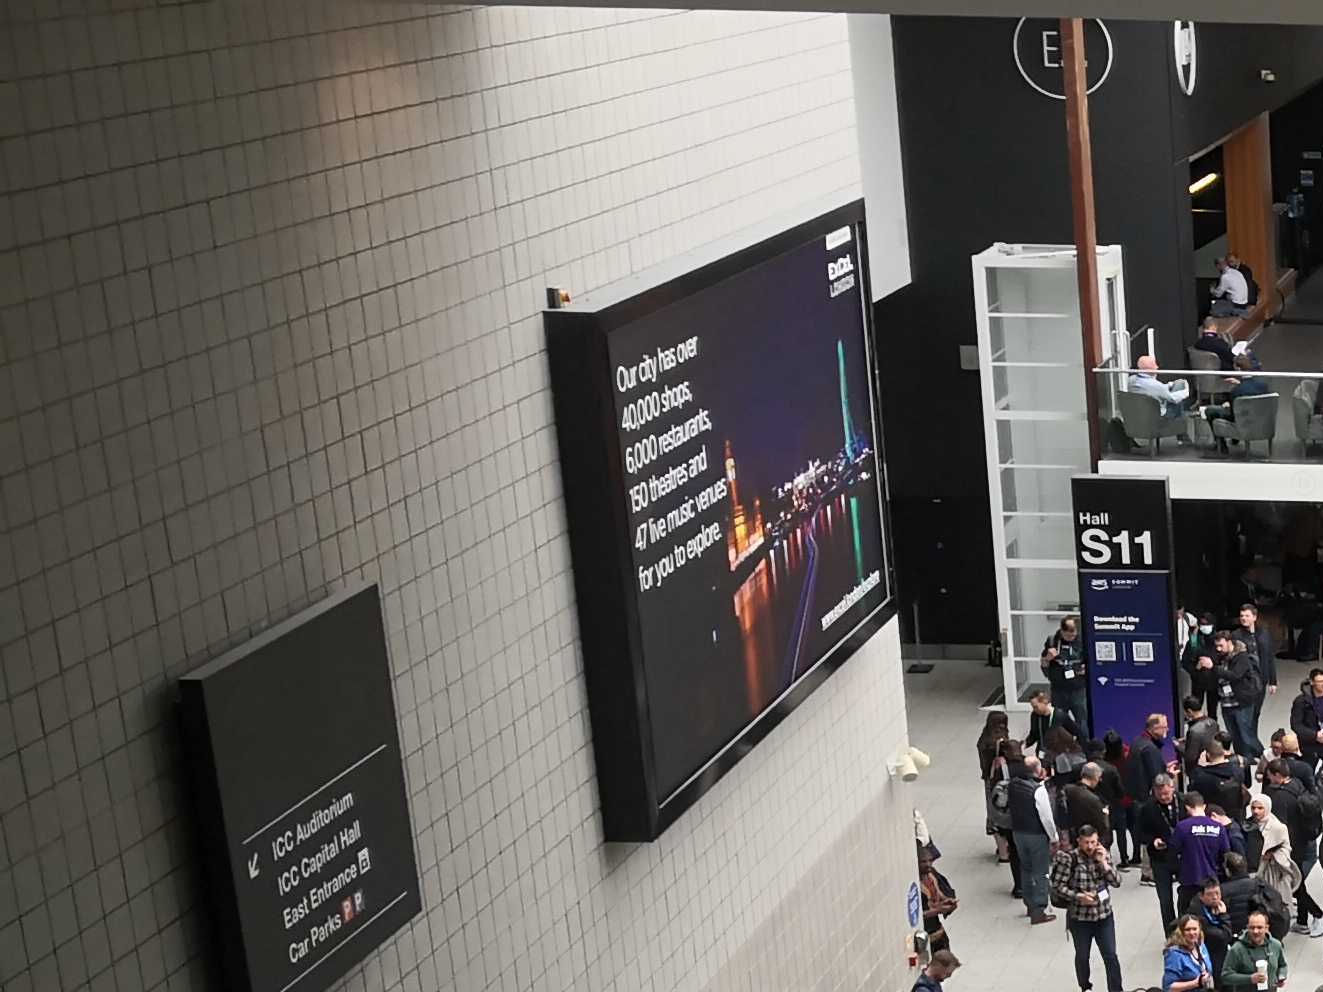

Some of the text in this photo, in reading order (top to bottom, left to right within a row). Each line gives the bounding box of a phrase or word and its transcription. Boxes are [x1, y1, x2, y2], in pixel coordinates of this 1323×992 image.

[616, 336, 699, 393] Our city has over
[621, 381, 694, 432] 40,000 shops,
[625, 408, 712, 474] 6,000 restaurants,
[629, 444, 708, 514] 150 theatres and
[635, 477, 728, 552] 47 live music venues
[1079, 512, 1109, 525] Hall
[1081, 528, 1153, 565] S11
[638, 522, 722, 593] for you to explore.
[271, 792, 354, 861] ICC Auditorium
[277, 820, 362, 897] ICC Capital Hall
[282, 863, 358, 929] East Entrance
[288, 938, 311, 963] Car
[310, 912, 342, 948] Parks
